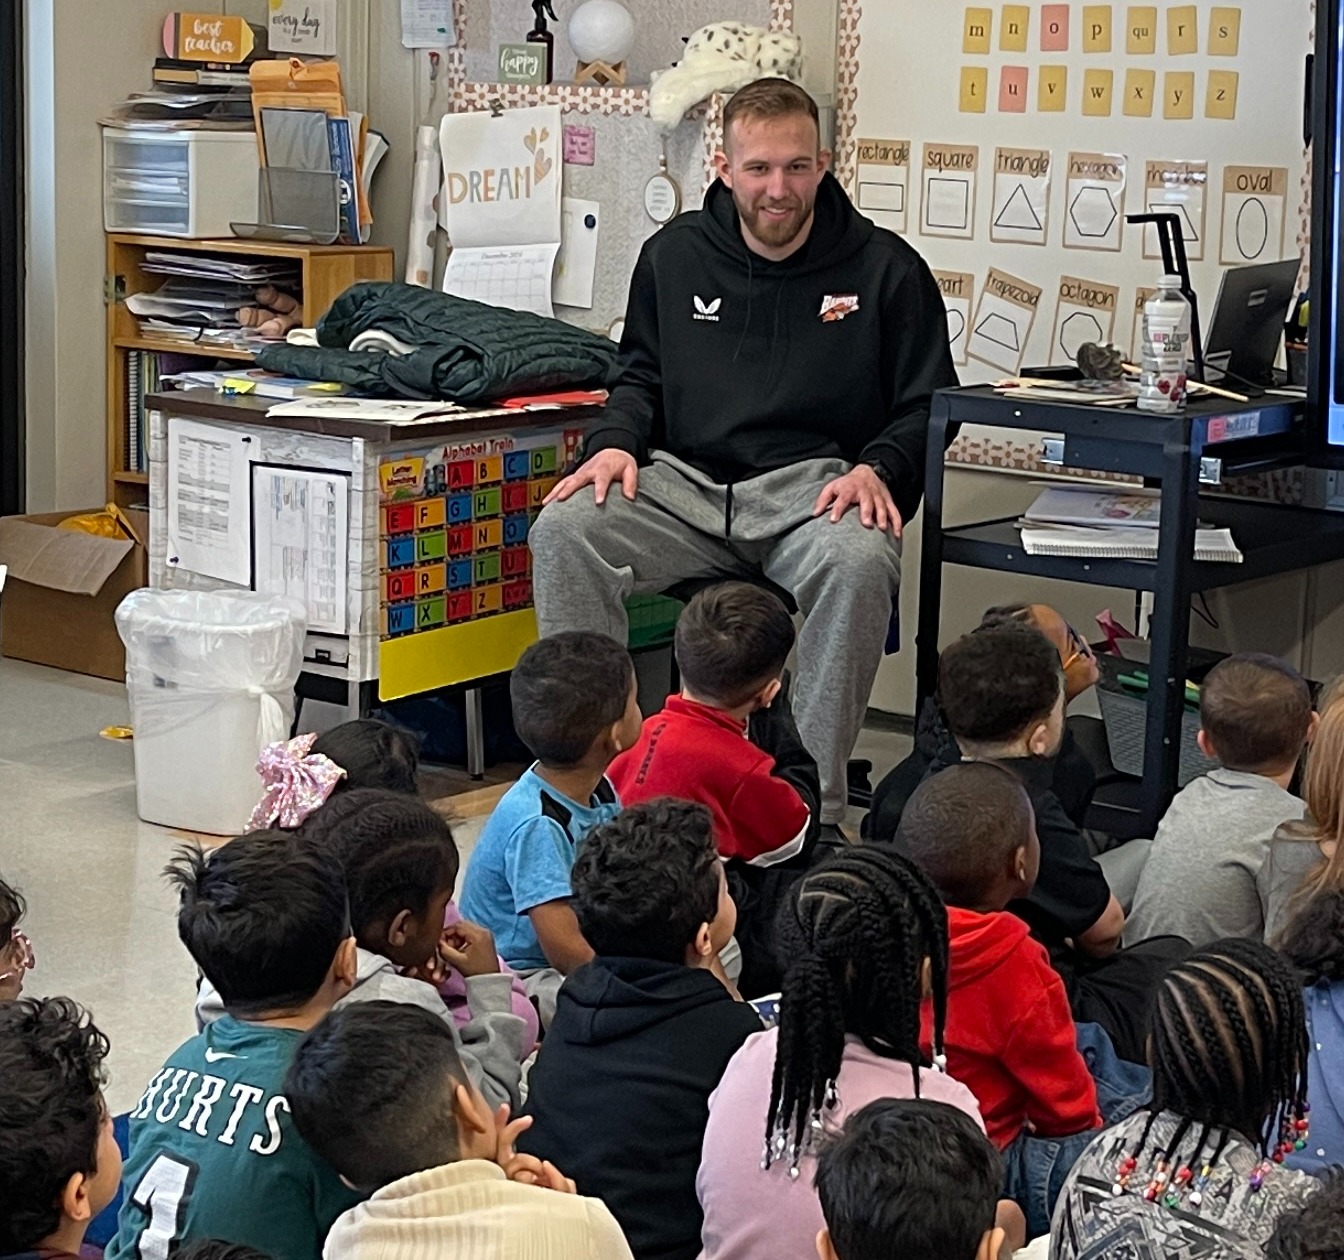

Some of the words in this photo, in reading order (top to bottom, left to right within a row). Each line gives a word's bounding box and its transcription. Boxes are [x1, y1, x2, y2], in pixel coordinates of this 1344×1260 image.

[194, 19, 224, 37] best
[302, 7, 320, 38] day
[969, 25, 984, 37] m
[1008, 22, 1019, 34] n
[1049, 22, 1059, 34] o
[1178, 24, 1185, 37] r
[1092, 24, 1102, 40] p
[1132, 27, 1148, 40] qu
[1219, 26, 1228, 38] s
[184, 36, 236, 55] teacher
[501, 48, 538, 76] happy
[970, 83, 976, 96] t
[1009, 84, 1018, 95] u
[1047, 83, 1057, 94] v
[1091, 87, 1105, 98] w
[1134, 87, 1143, 99] x
[1216, 89, 1225, 101] z
[1173, 89, 1183, 106] y
[857, 143, 909, 166] rectangle
[927, 150, 974, 173] square
[998, 151, 1050, 178] triangle
[448, 166, 531, 204] DREAM
[1237, 169, 1272, 192] oval
[939, 277, 964, 296] eart
[988, 272, 1041, 306] trapezoid
[1060, 282, 1115, 307] octagon
[442, 441, 487, 461] Alphabet
[489, 438, 514, 451] Train
[507, 457, 516, 474] C
[534, 452, 543, 469] D
[452, 467, 461, 483] A
[480, 462, 488, 479] B
[533, 485, 541, 501] J
[450, 502, 460, 518] G
[477, 496, 486, 512] H
[391, 512, 398, 529] E
[421, 507, 428, 523] F
[478, 528, 488, 544] N
[507, 521, 517, 538] O
[422, 539, 429, 556] L
[450, 534, 461, 550] M
[391, 544, 401, 561] K
[478, 561, 485, 577] T
[506, 553, 514, 570] U
[421, 573, 429, 589] R
[450, 566, 459, 582] S
[391, 578, 402, 595] Q
[452, 599, 459, 615] Y
[478, 593, 486, 609] Z
[391, 611, 403, 628] W
[421, 605, 431, 622] X
[130, 1067, 291, 1155] HURTS
[133, 1155, 190, 1260] 1
